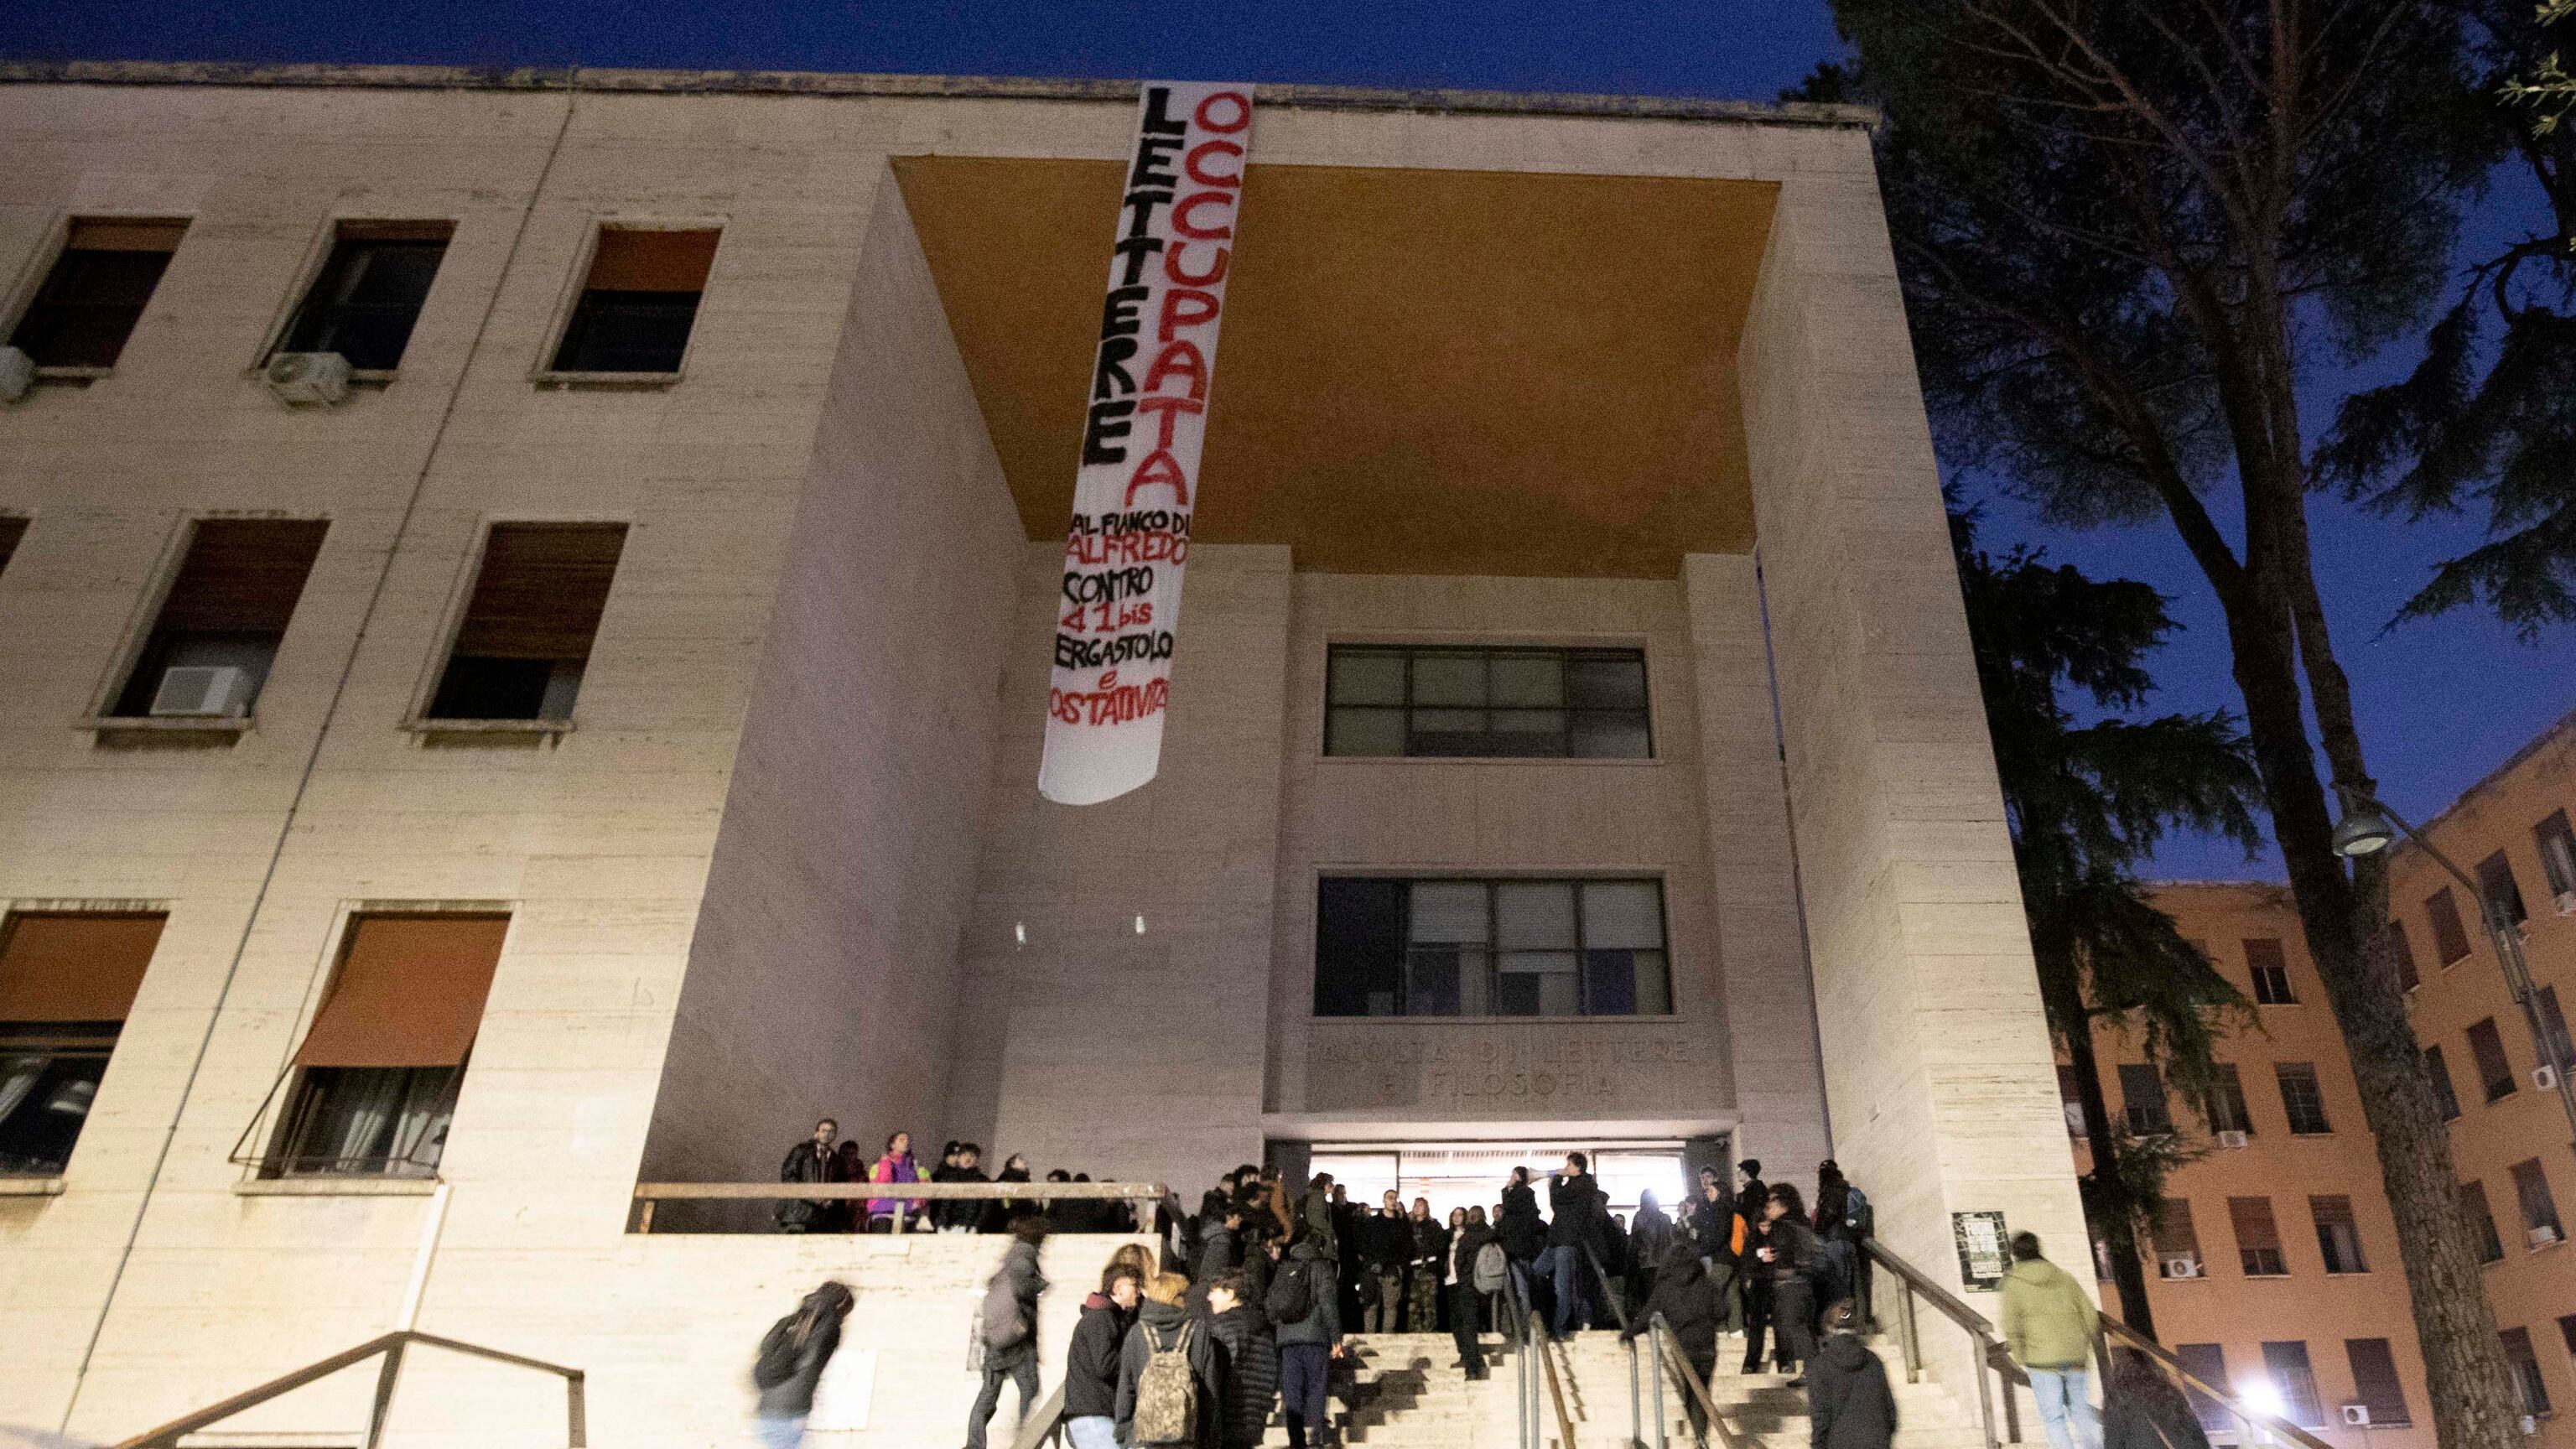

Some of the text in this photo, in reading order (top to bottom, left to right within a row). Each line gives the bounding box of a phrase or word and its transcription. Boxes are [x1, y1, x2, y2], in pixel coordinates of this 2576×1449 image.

[1082, 87, 1187, 466] LETTERE
[1124, 91, 1252, 508] OCCUPATA
[1071, 512, 1099, 536] AL
[1172, 512, 1191, 536] DI
[1066, 531, 1190, 566] ALFREDO
[1062, 566, 1154, 604] CONTRO
[1061, 602, 1154, 633] 41 bis
[1054, 631, 1174, 670] ERGASTOLO
[1545, 1040, 1688, 1063] LETTERE
[1430, 1072, 1616, 1097] FILOSOFIA
